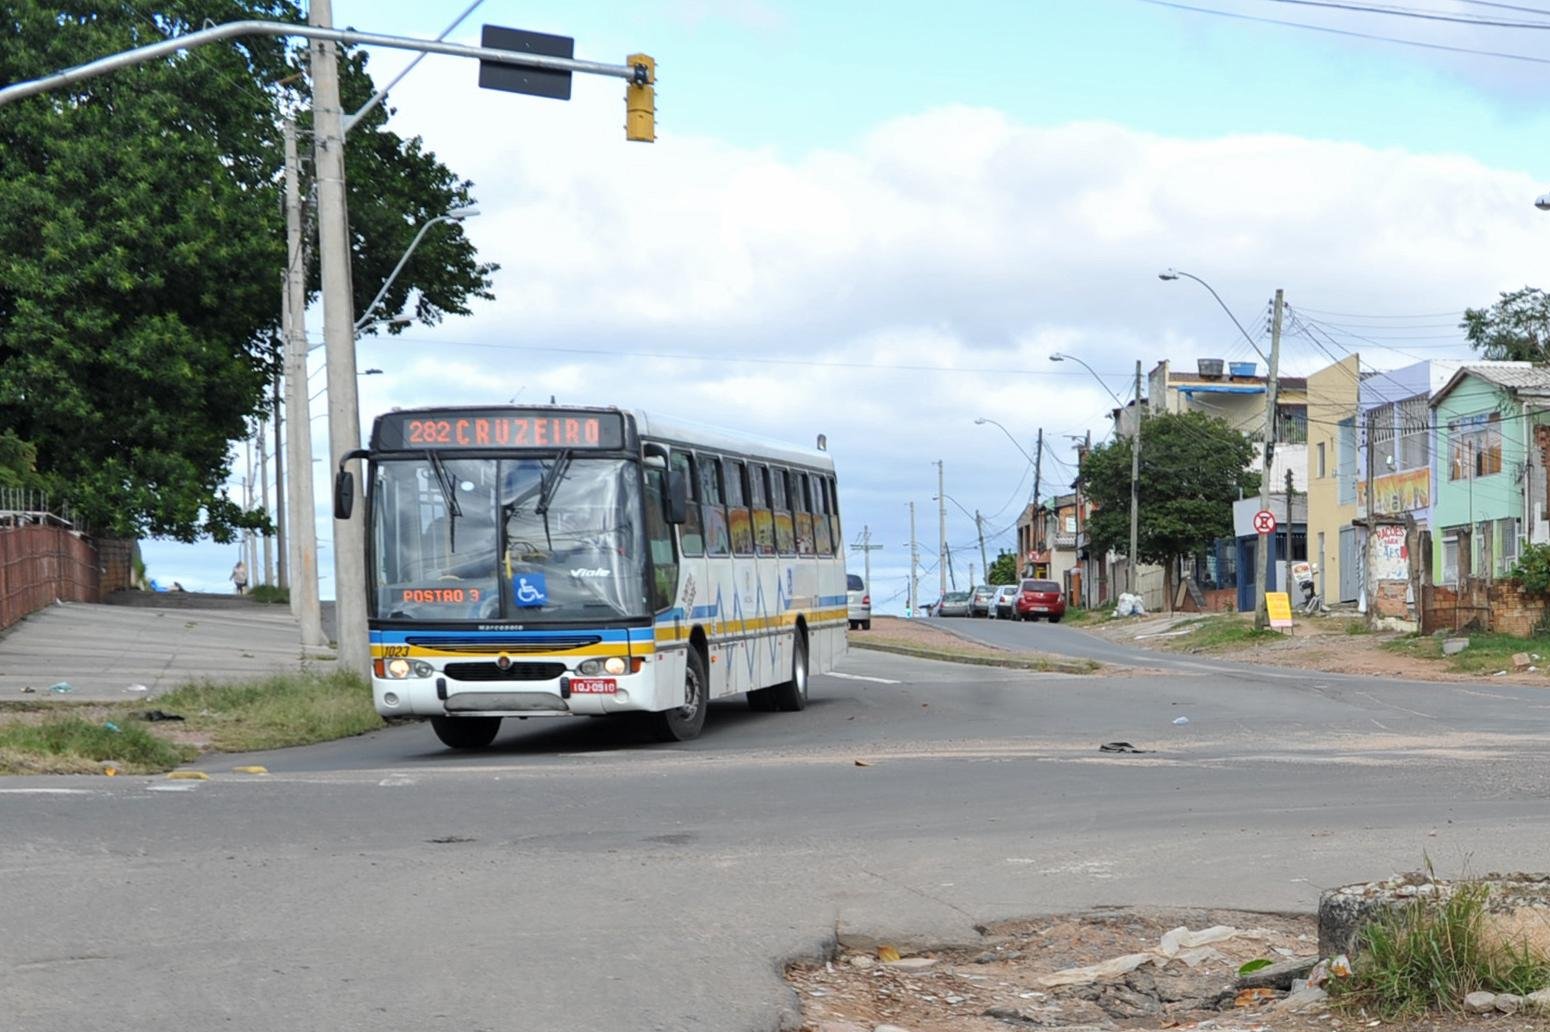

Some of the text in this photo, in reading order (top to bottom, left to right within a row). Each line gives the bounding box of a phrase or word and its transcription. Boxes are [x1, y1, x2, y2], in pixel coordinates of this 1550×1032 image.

[410, 418, 600, 445] 282 CRUZEIRO
[470, 589, 480, 602] 3
[384, 645, 410, 658] 1023
